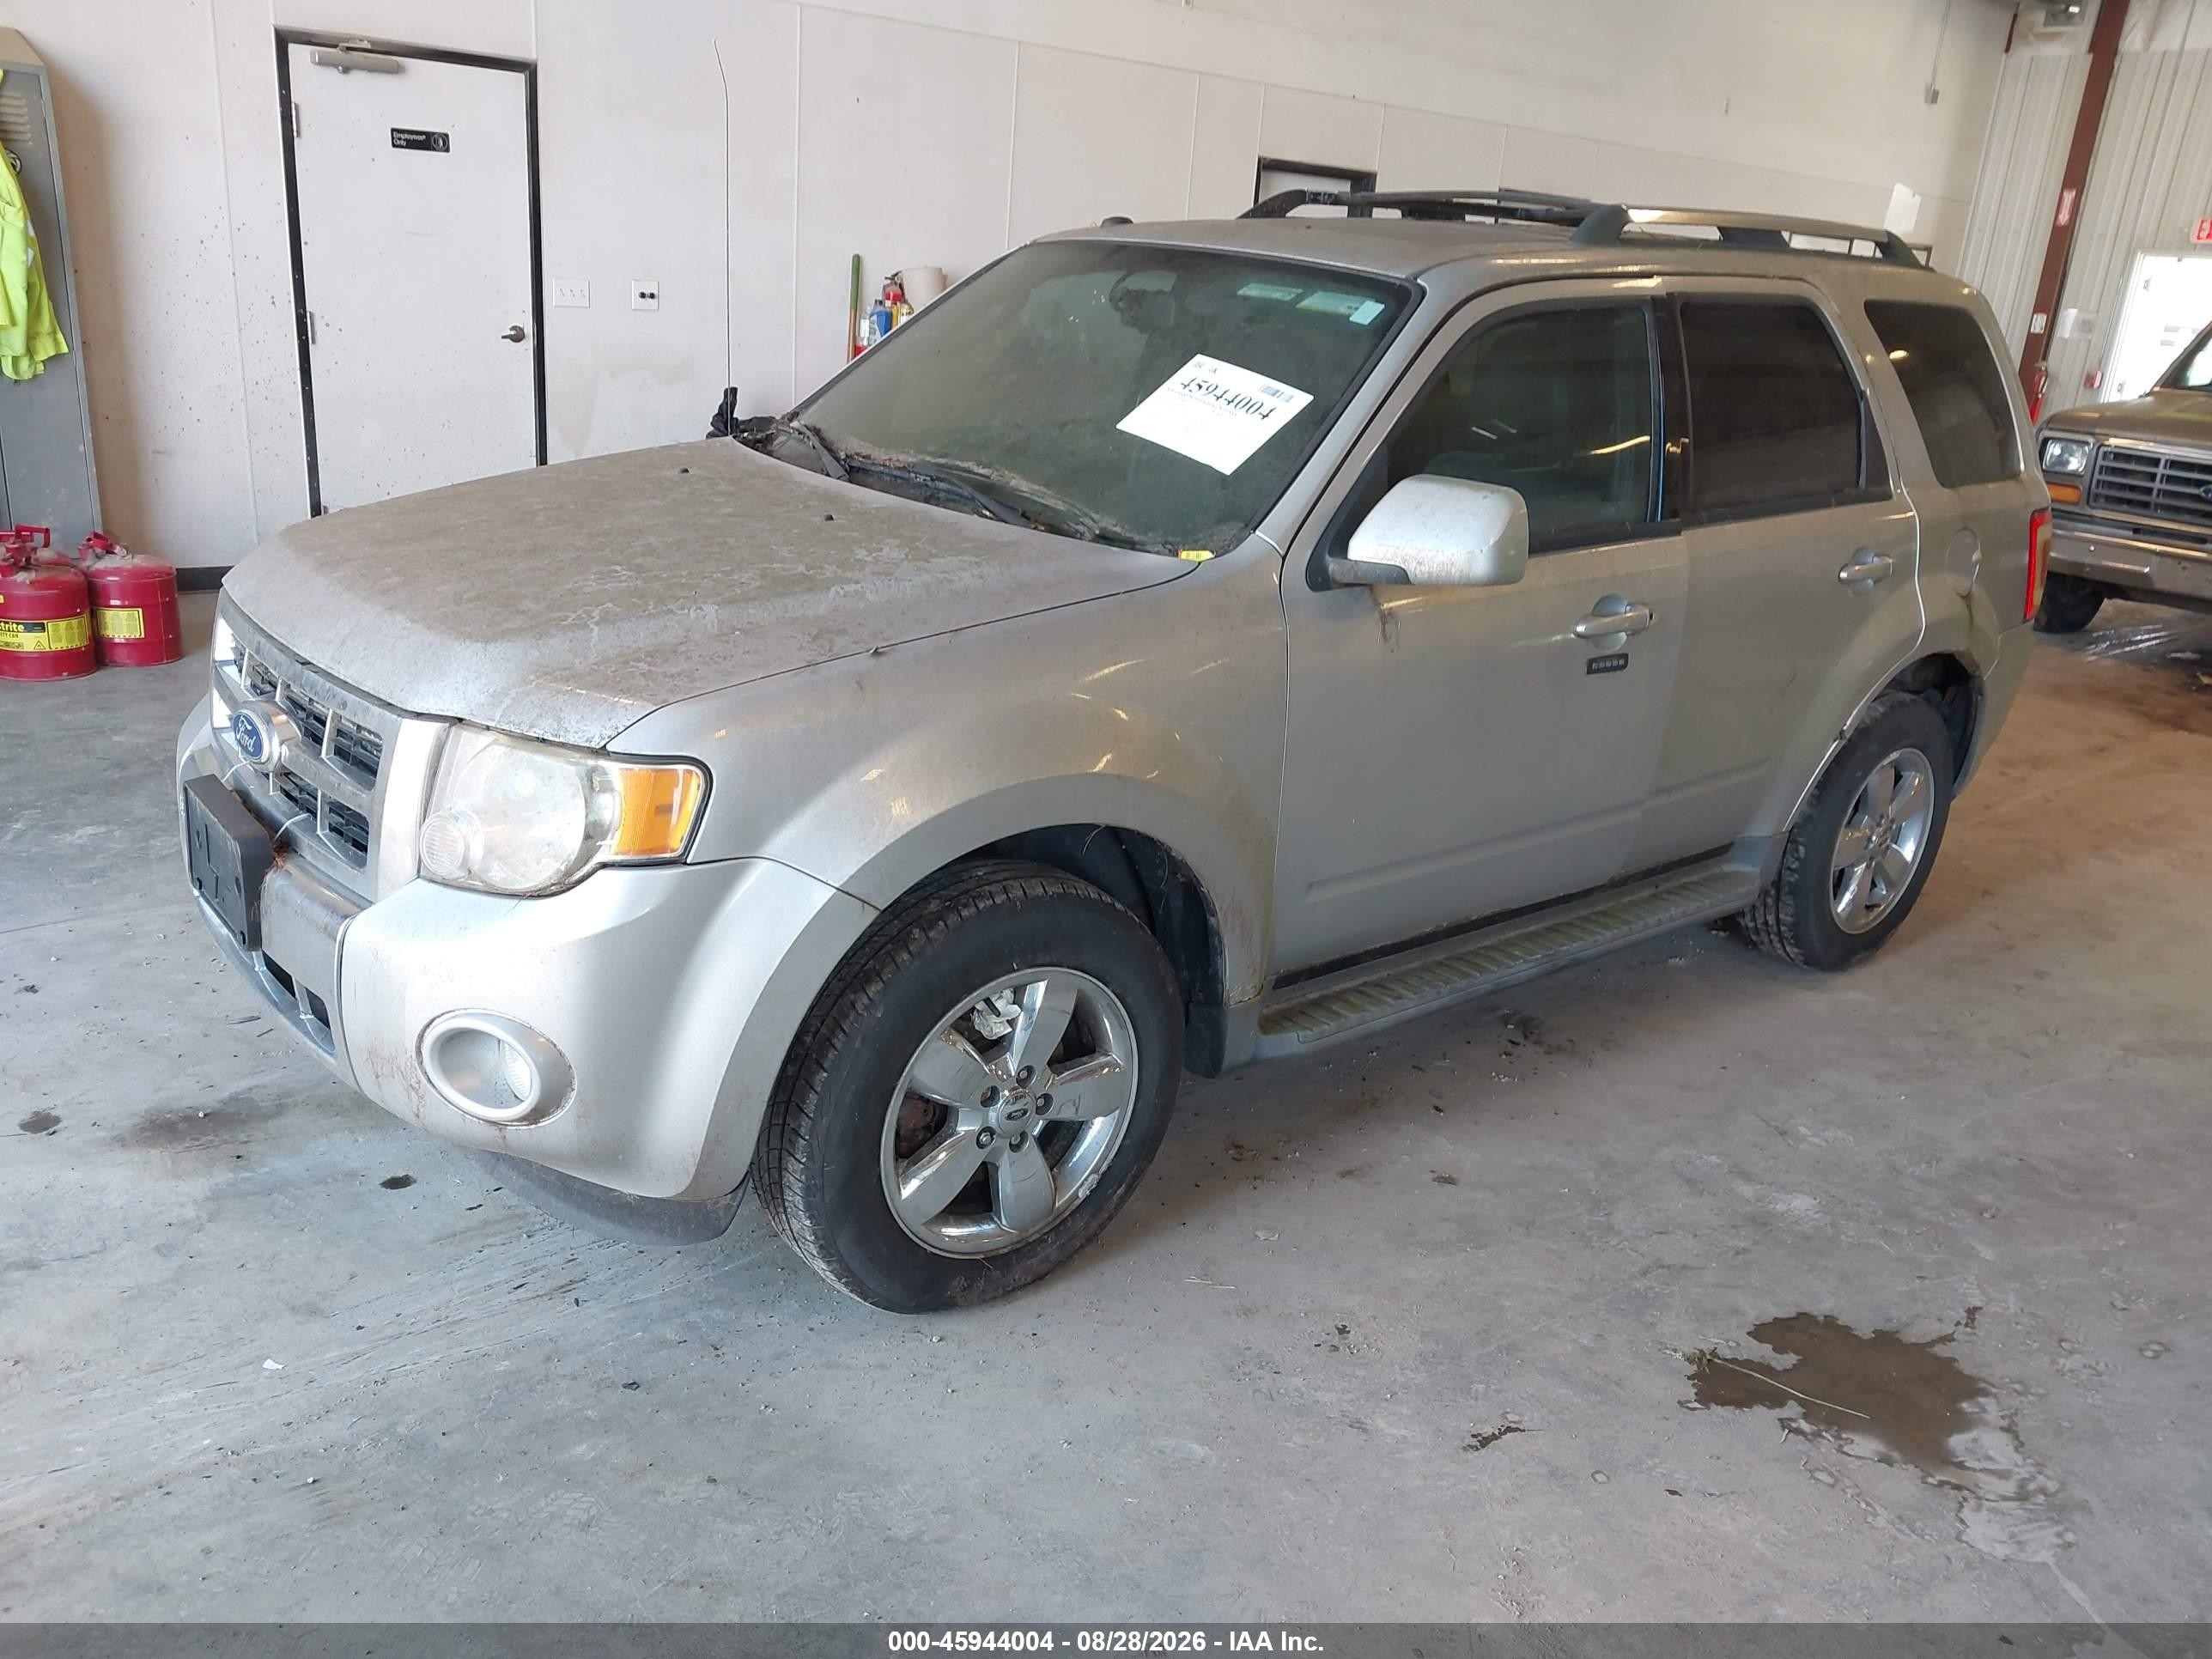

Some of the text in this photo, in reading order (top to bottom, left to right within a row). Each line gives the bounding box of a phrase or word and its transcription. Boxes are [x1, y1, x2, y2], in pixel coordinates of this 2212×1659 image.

[1180, 377, 1277, 420] 45944004
[0, 622, 26, 632] trite
[235, 714, 257, 753] Ford
